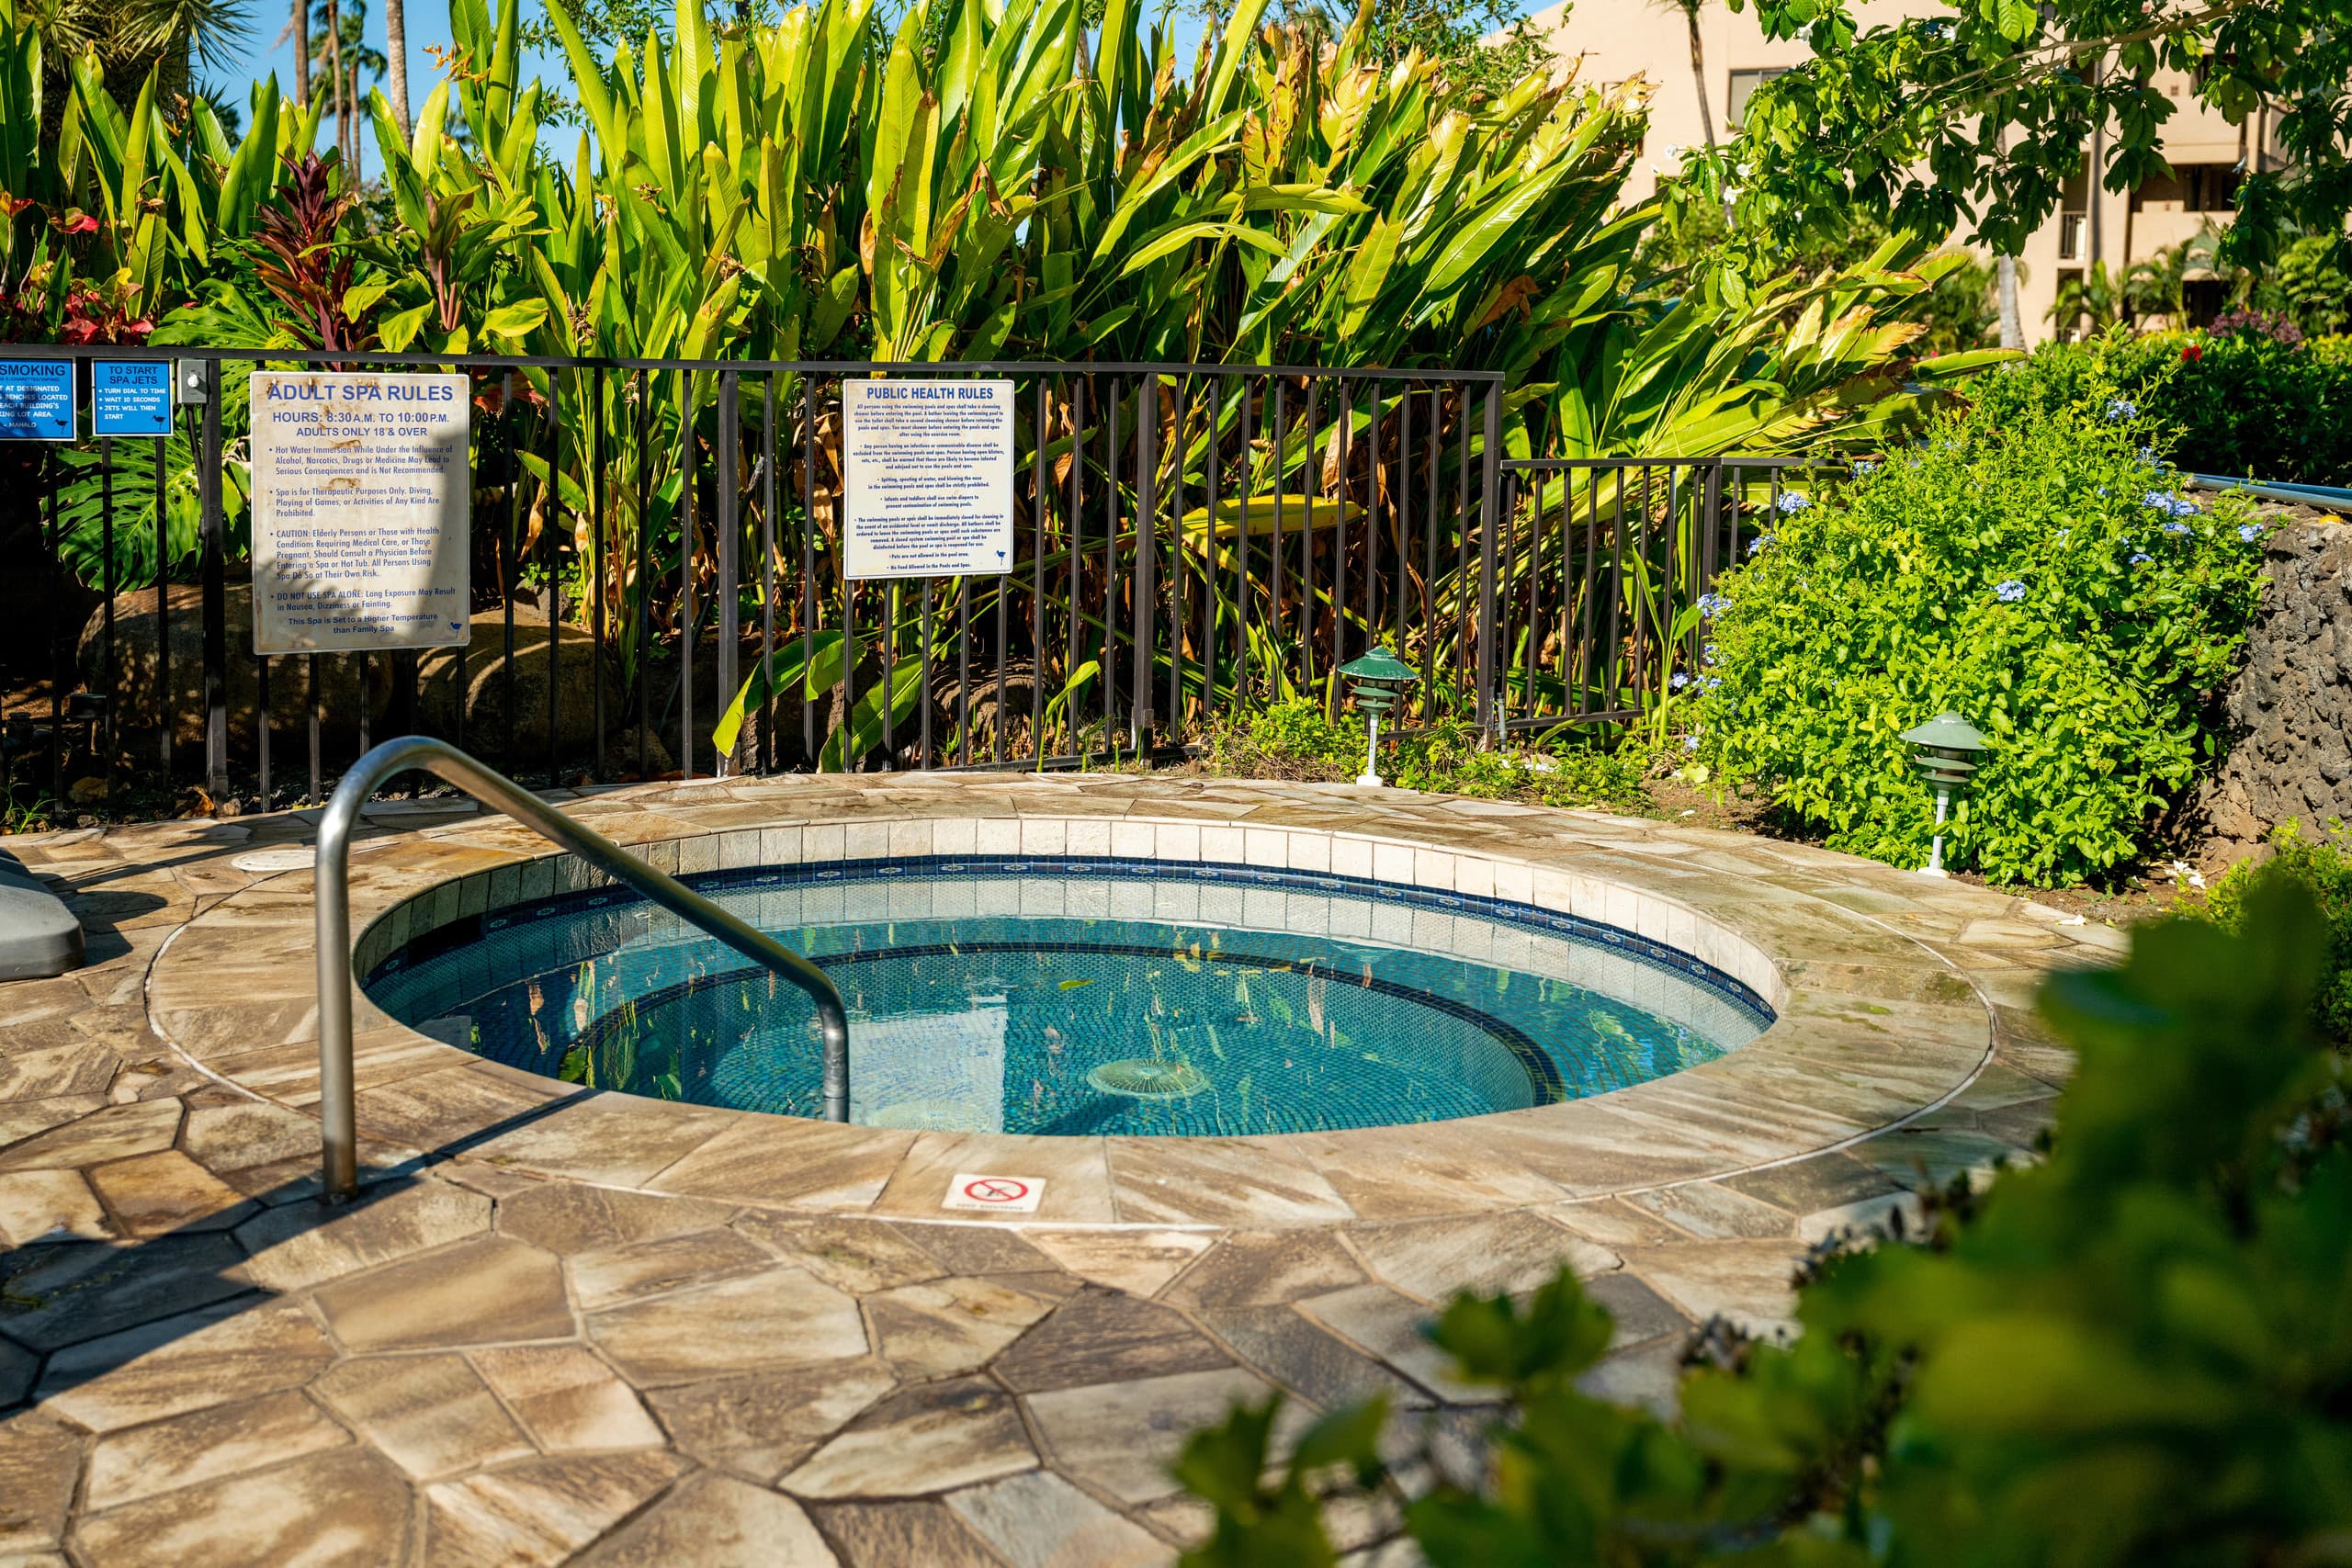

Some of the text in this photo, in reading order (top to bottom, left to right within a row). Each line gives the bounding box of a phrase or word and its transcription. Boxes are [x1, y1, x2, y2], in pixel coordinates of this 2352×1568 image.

[0, 365, 65, 376] SMOKING
[267, 385, 453, 401] ADULT SPA RULES
[867, 387, 993, 398] PUBLIC HEALTH RULES
[273, 412, 322, 422] HOURS:
[380, 413, 393, 422] TO
[305, 467, 353, 475] Consequences
[313, 488, 353, 496] Therapeutic
[276, 499, 303, 507] Playing
[313, 529, 337, 537] Elderly
[376, 548, 407, 557] Physician
[277, 561, 306, 569] Entering
[316, 561, 328, 569] Spa
[412, 558, 431, 567] Using
[366, 590, 382, 598] Long
[385, 589, 415, 597] Exposure
[418, 588, 432, 596] May
[364, 615, 389, 623] Higher
[393, 613, 438, 622] Temperature
